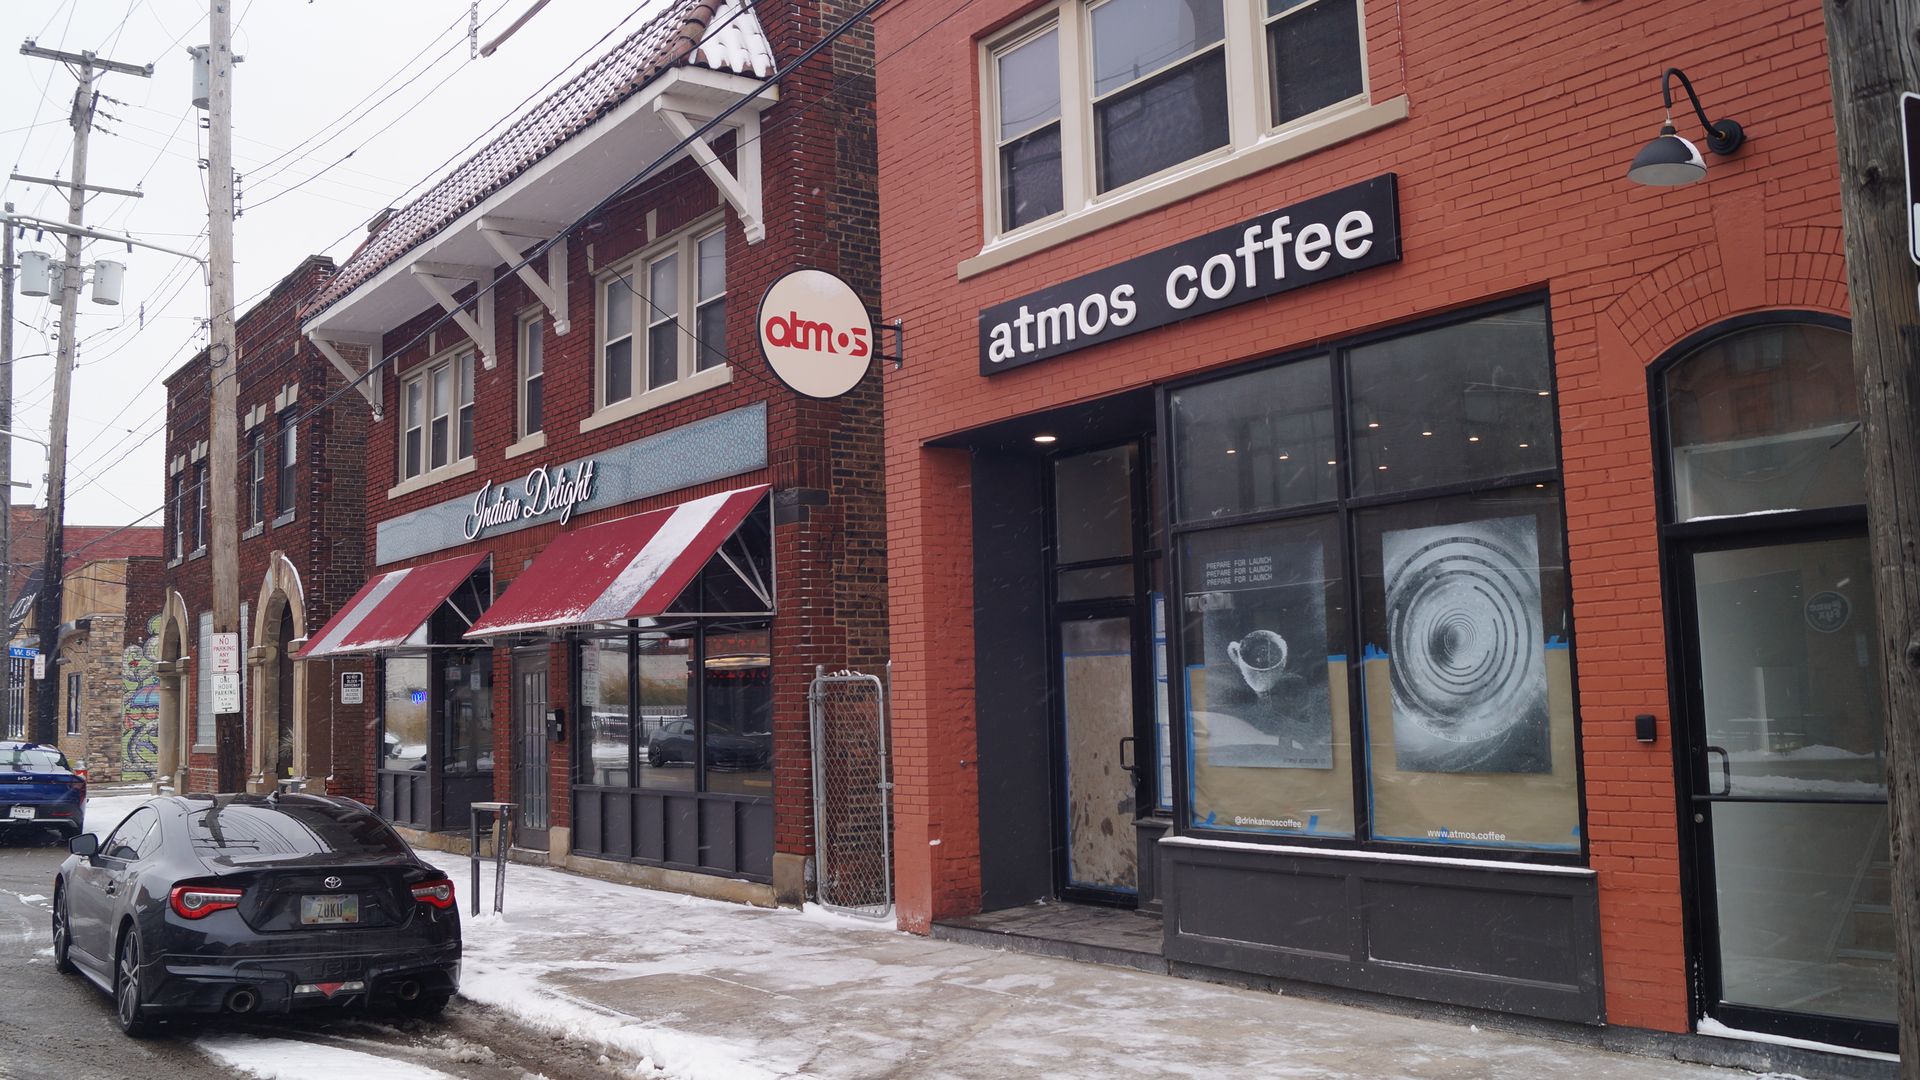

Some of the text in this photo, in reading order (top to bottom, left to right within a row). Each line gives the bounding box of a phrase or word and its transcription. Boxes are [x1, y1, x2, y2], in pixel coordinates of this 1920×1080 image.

[988, 210, 1374, 362] atmos coffee
[765, 311, 868, 357] atmos
[464, 460, 595, 540] Indian Delight
[1206, 556, 1272, 569] PREPARE FOR LAUNCH
[1206, 565, 1272, 577] PREPARE FOR LAUNCH
[1206, 573, 1272, 586] PREPARE FOR LAUNCH
[1234, 815, 1302, 828] @drinkatmoscoffee
[1427, 830, 1506, 841] www.atmos.coffee
[318, 903, 343, 918] ZUKU
